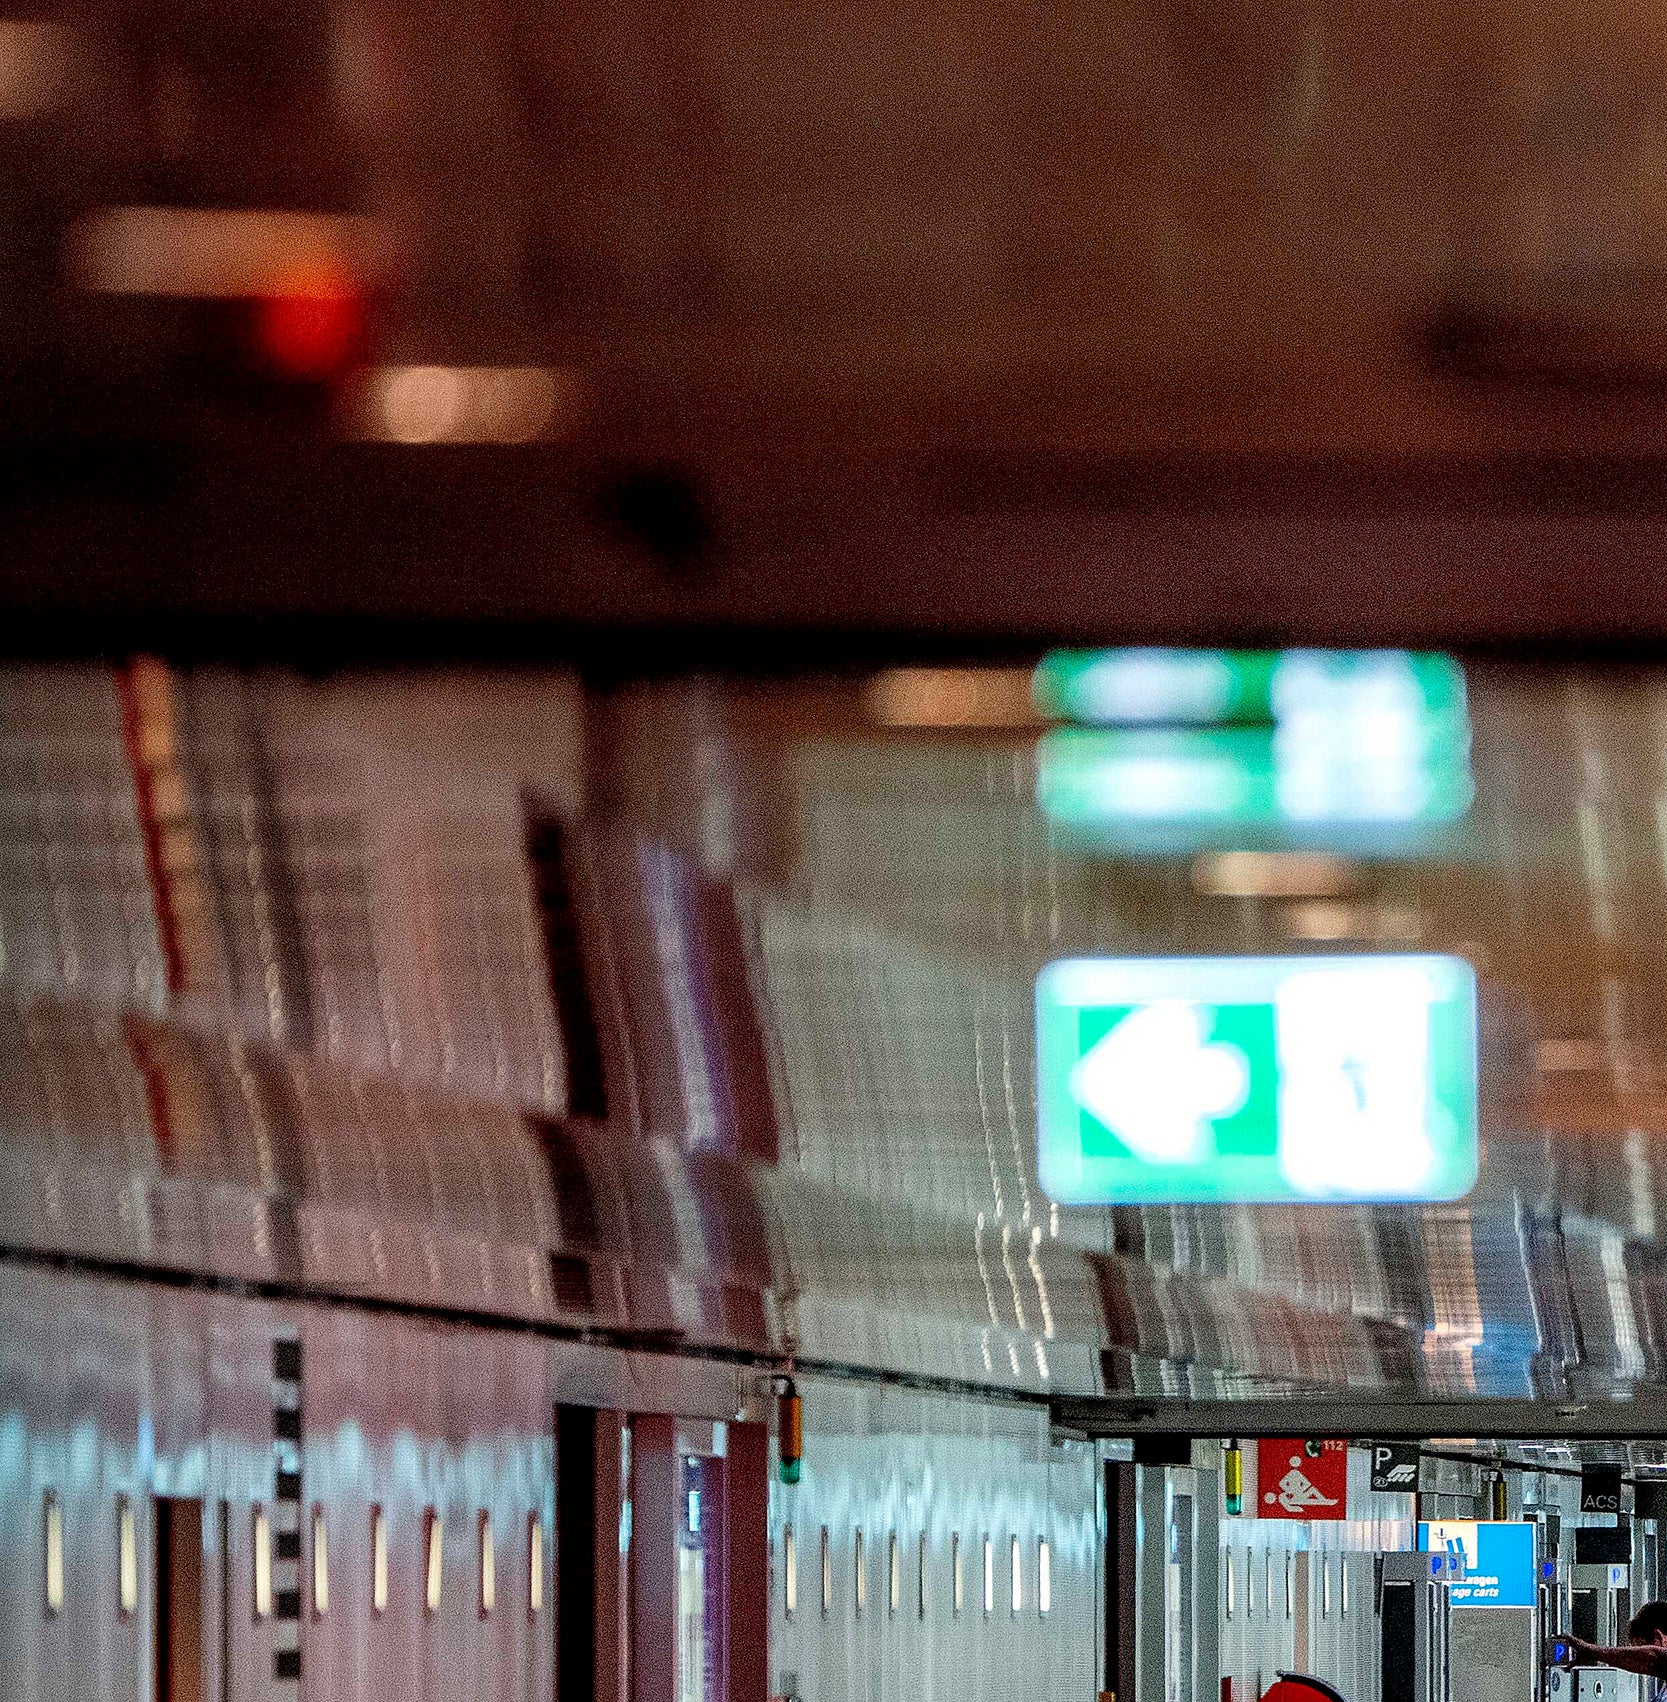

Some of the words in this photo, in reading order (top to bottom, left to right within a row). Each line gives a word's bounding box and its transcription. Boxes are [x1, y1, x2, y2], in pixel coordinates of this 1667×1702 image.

[1323, 1440, 1344, 1450] 112
[1375, 1447, 1392, 1470] P
[1583, 1494, 1618, 1510] ACS
[1431, 1556, 1442, 1575] P
[1474, 1587, 1499, 1597] carts
[1555, 1643, 1565, 1662] P
